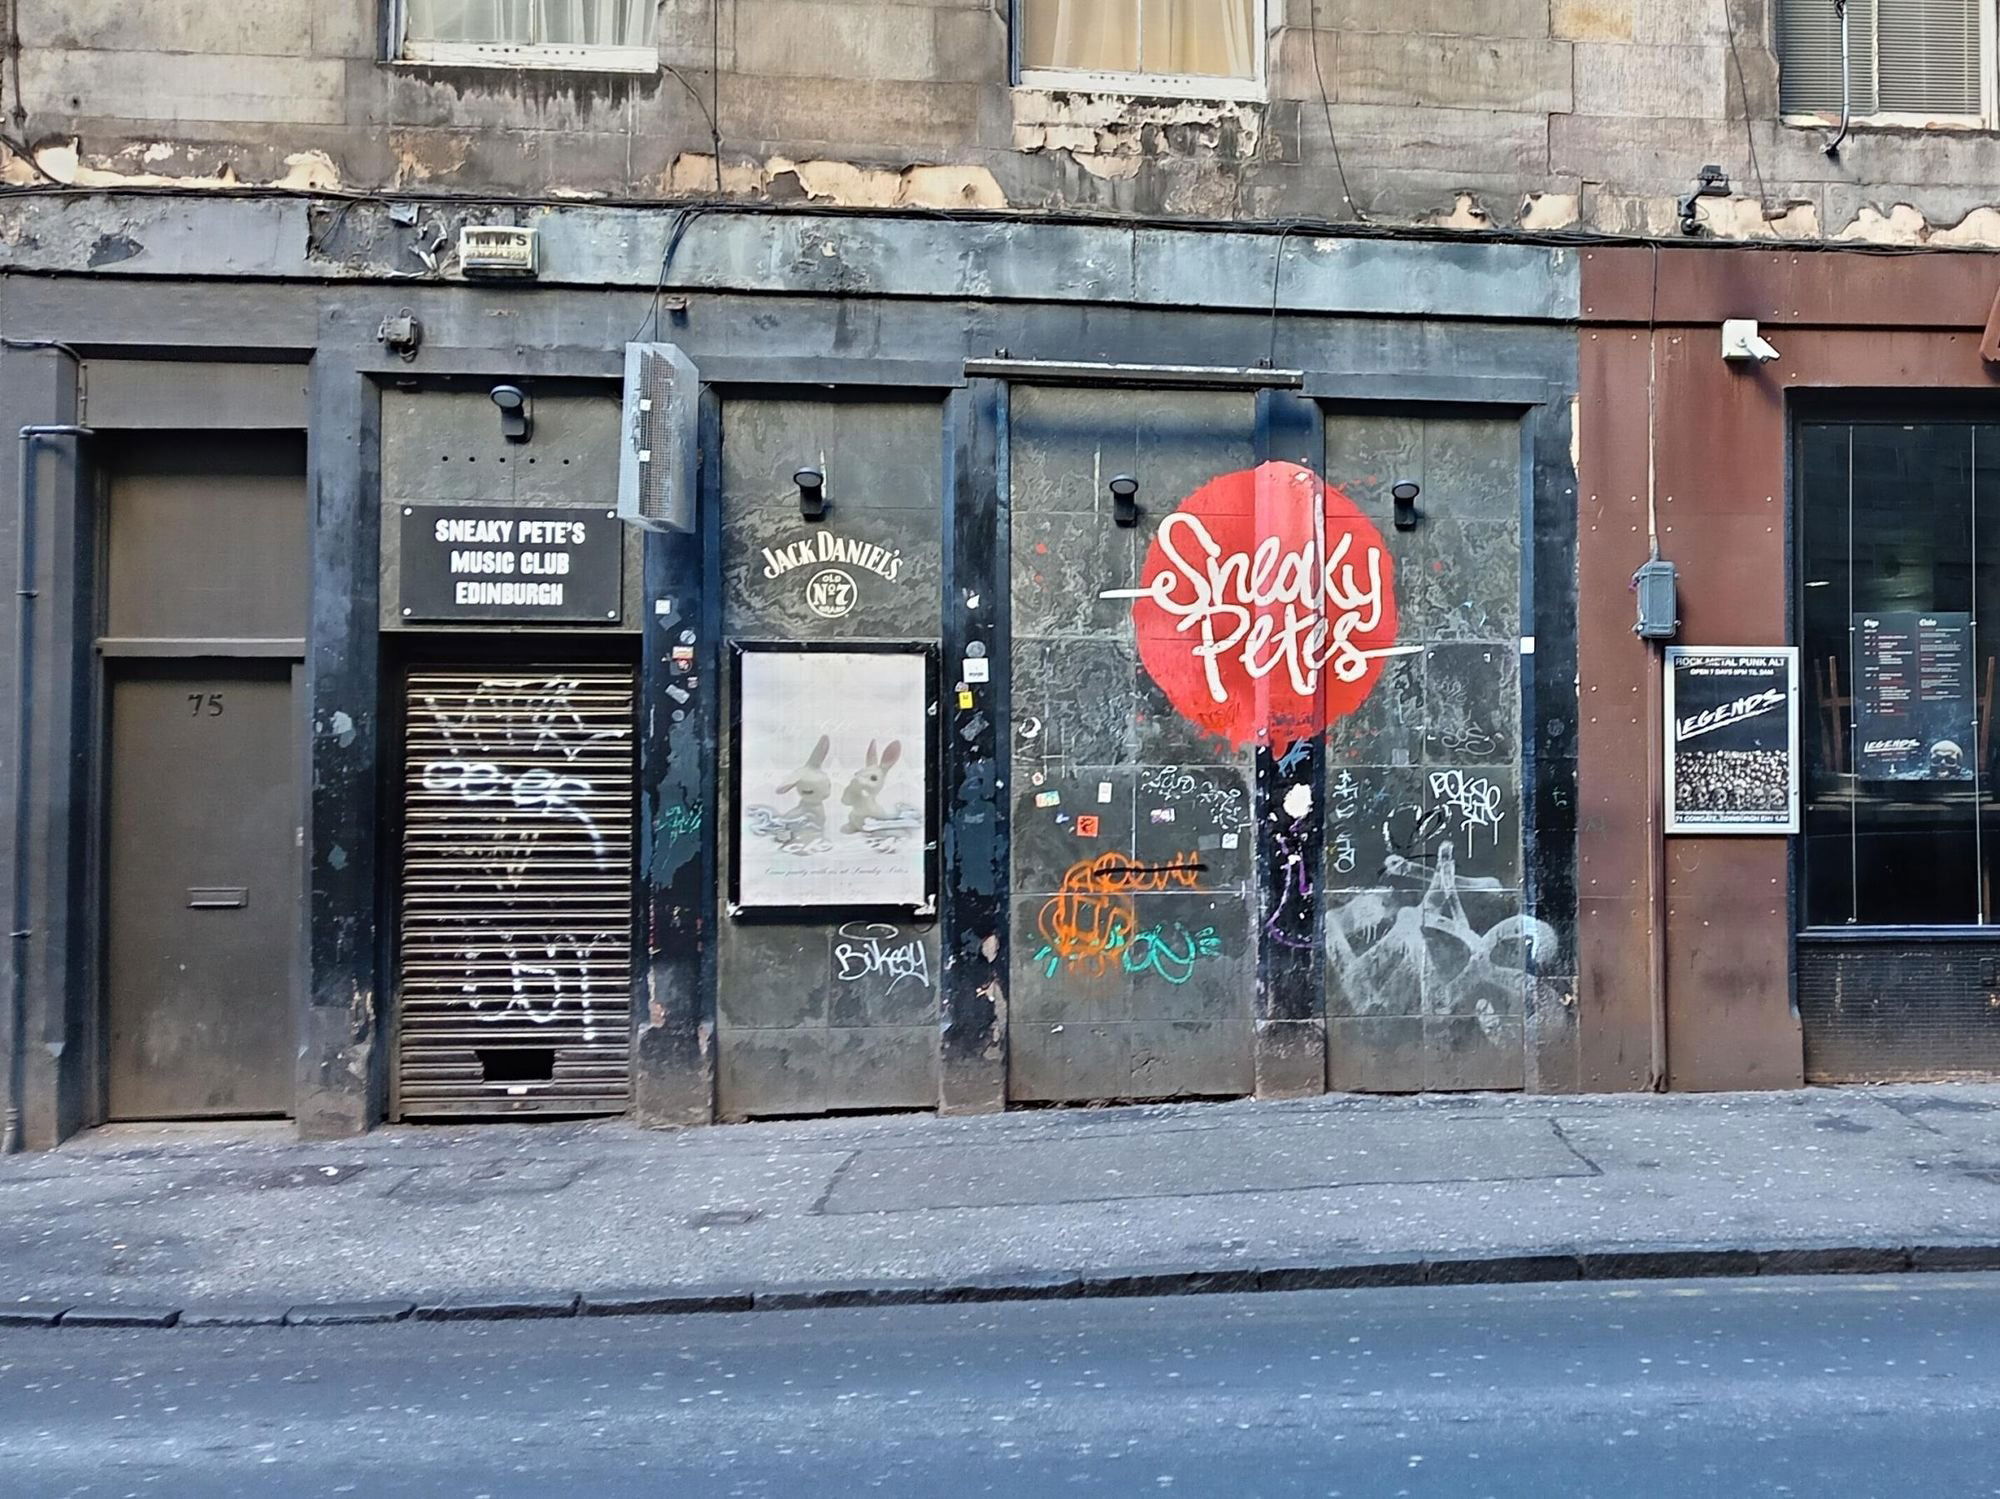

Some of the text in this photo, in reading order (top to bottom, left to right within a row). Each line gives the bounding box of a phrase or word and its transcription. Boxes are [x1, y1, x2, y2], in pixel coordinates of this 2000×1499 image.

[435, 519, 586, 544] SNEAKY PETE'S
[450, 550, 570, 575] MUSIC CLUB
[761, 530, 903, 582] JACK DANIEL'S
[1099, 494, 1384, 633] Sneaky
[822, 574, 842, 583] OLD
[455, 581, 564, 606] EDINBURGH
[1191, 602, 1425, 704] Petes
[1675, 657, 1785, 667] ROCK METAL PUNK ALT
[1689, 668, 1709, 676] OPEN
[1714, 668, 1733, 676] DAYS
[187, 694, 224, 717] 75
[1676, 688, 1786, 742] LEGENDS
[1863, 738, 1921, 753] LEGENDS
